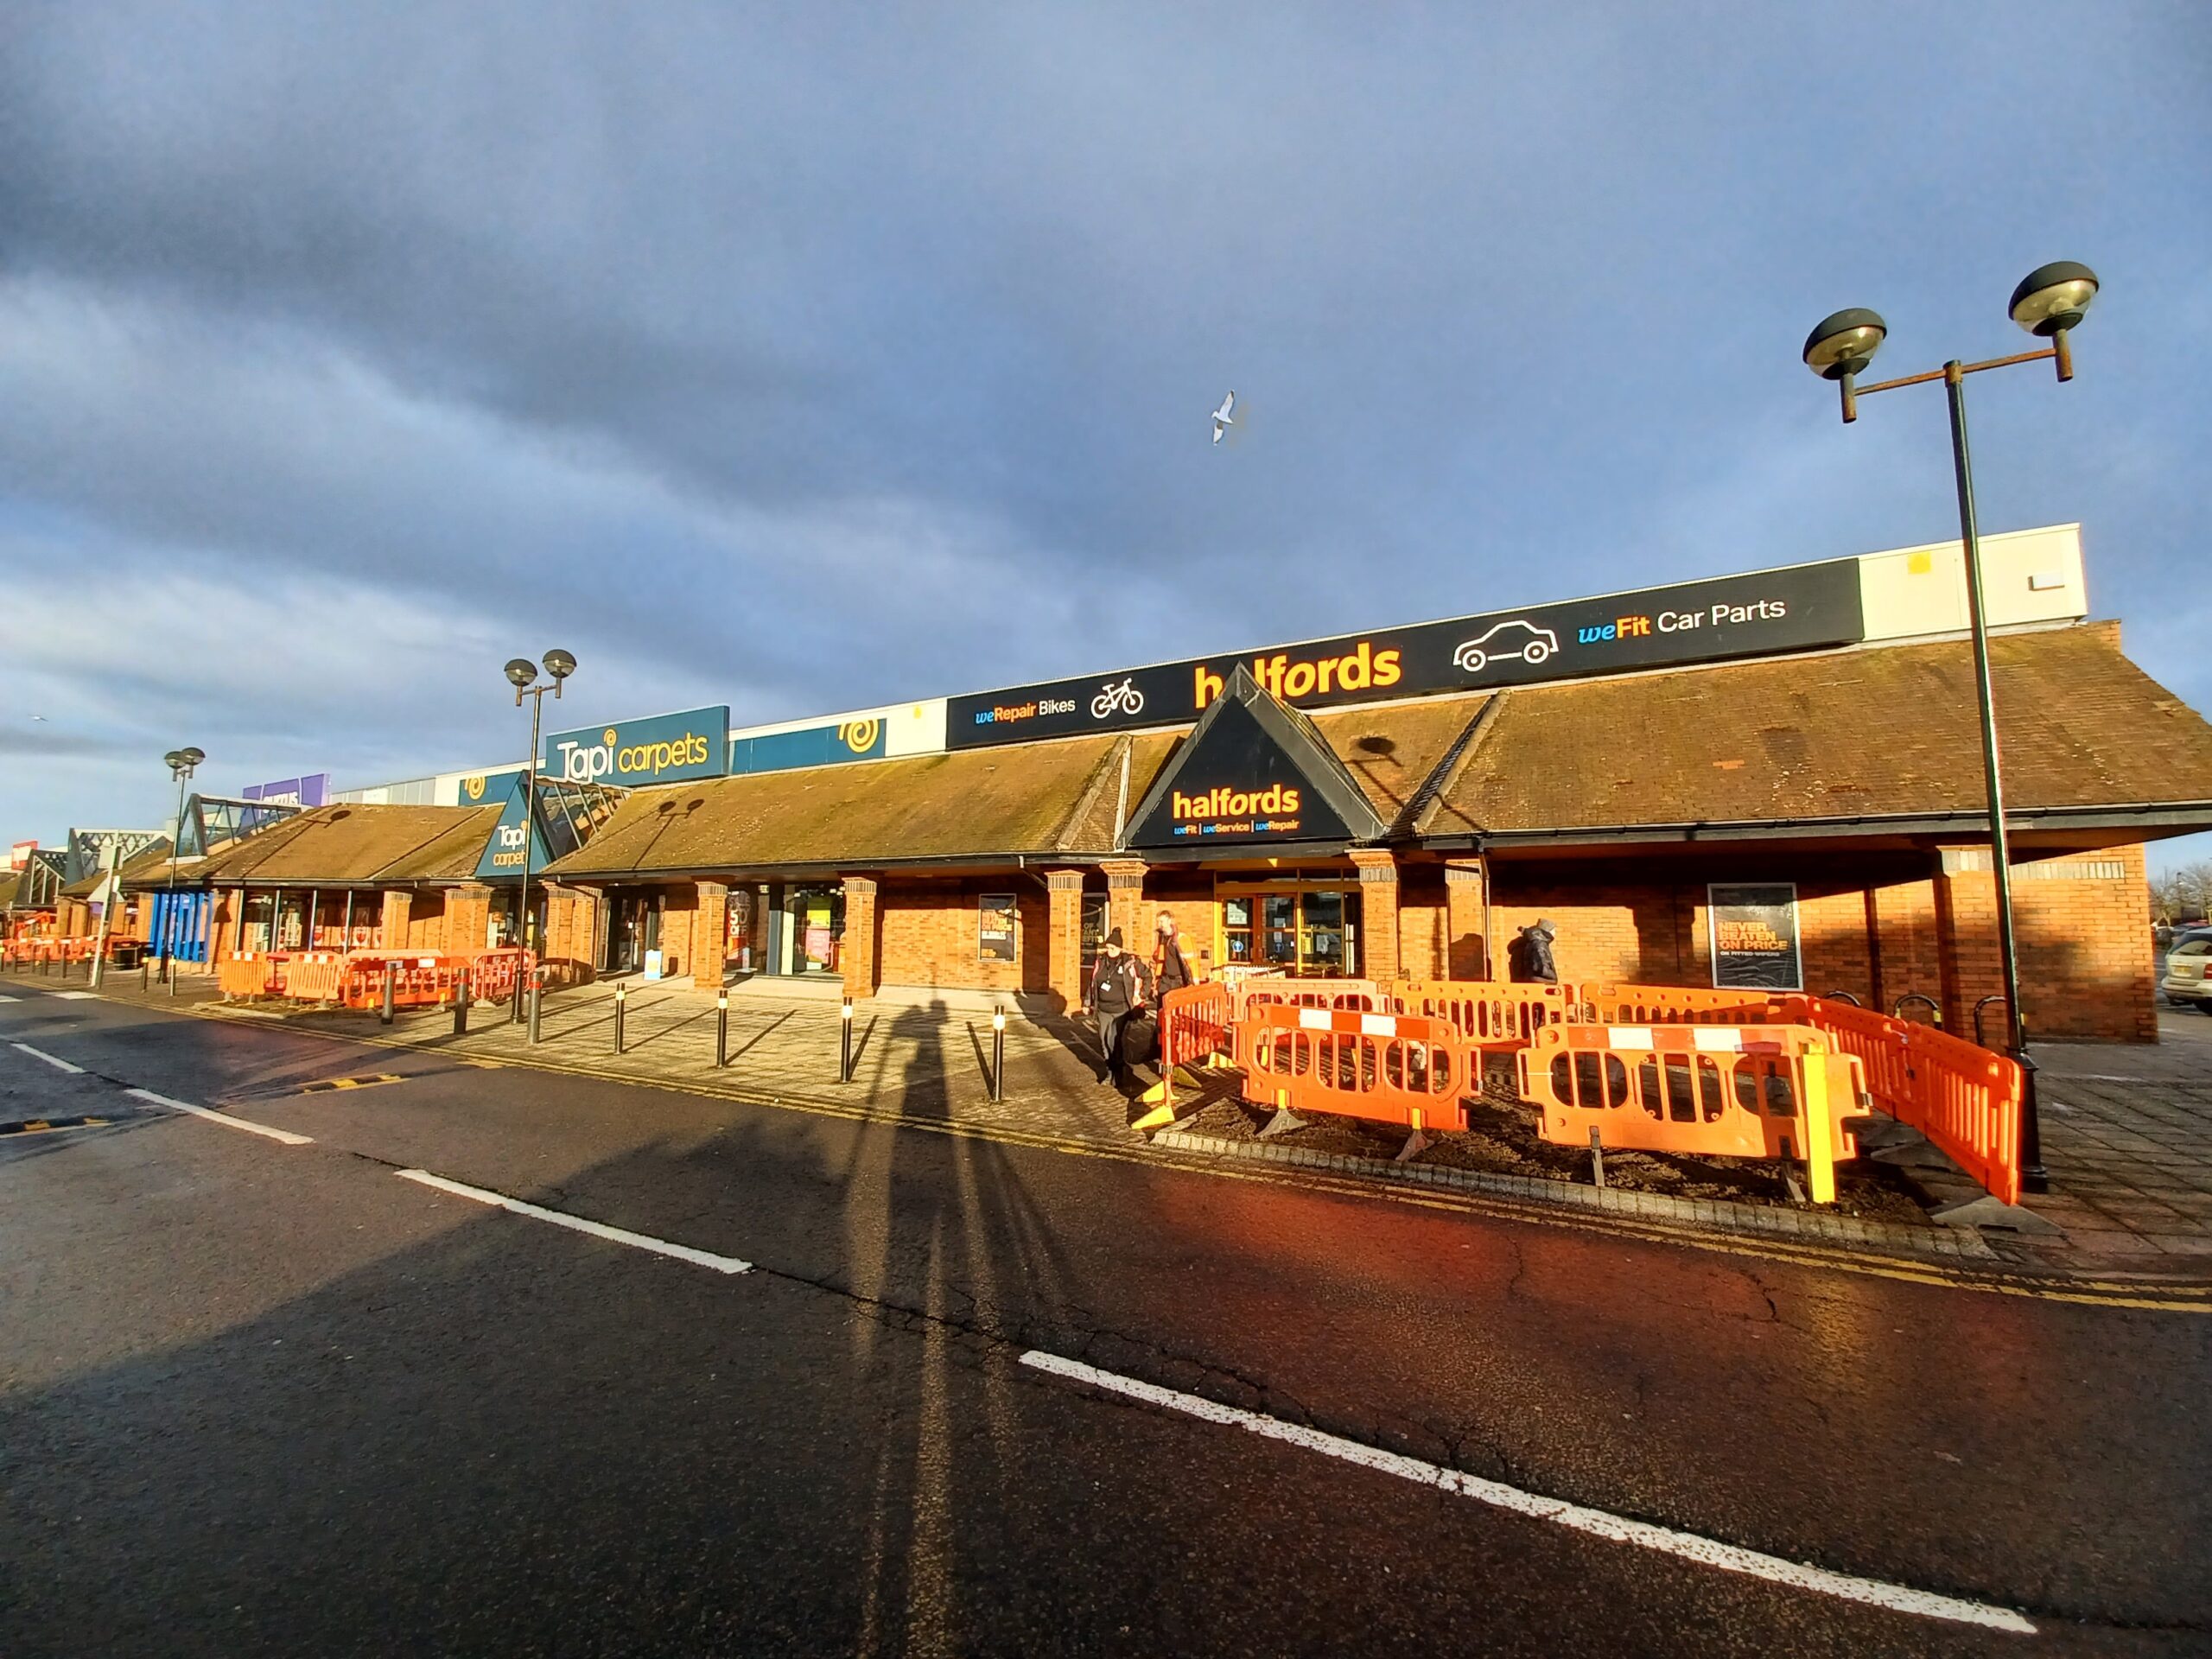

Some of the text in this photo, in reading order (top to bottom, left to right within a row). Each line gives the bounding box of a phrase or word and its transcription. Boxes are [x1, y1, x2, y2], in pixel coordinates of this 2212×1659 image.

[1578, 600, 1786, 644] weFit Car Parts
[1194, 642, 1402, 709] hlfords
[975, 699, 1076, 724] weRepair Bikes
[556, 728, 708, 783] Tapi carpets
[1173, 784, 1300, 819] halfords
[498, 820, 527, 850] Tapi
[1255, 819, 1300, 832] weRepair
[493, 849, 525, 868] carpet
[1718, 922, 1767, 931] NEVER
[1719, 931, 1777, 941] BEATEN
[1719, 940, 1789, 950] ON PRICE
